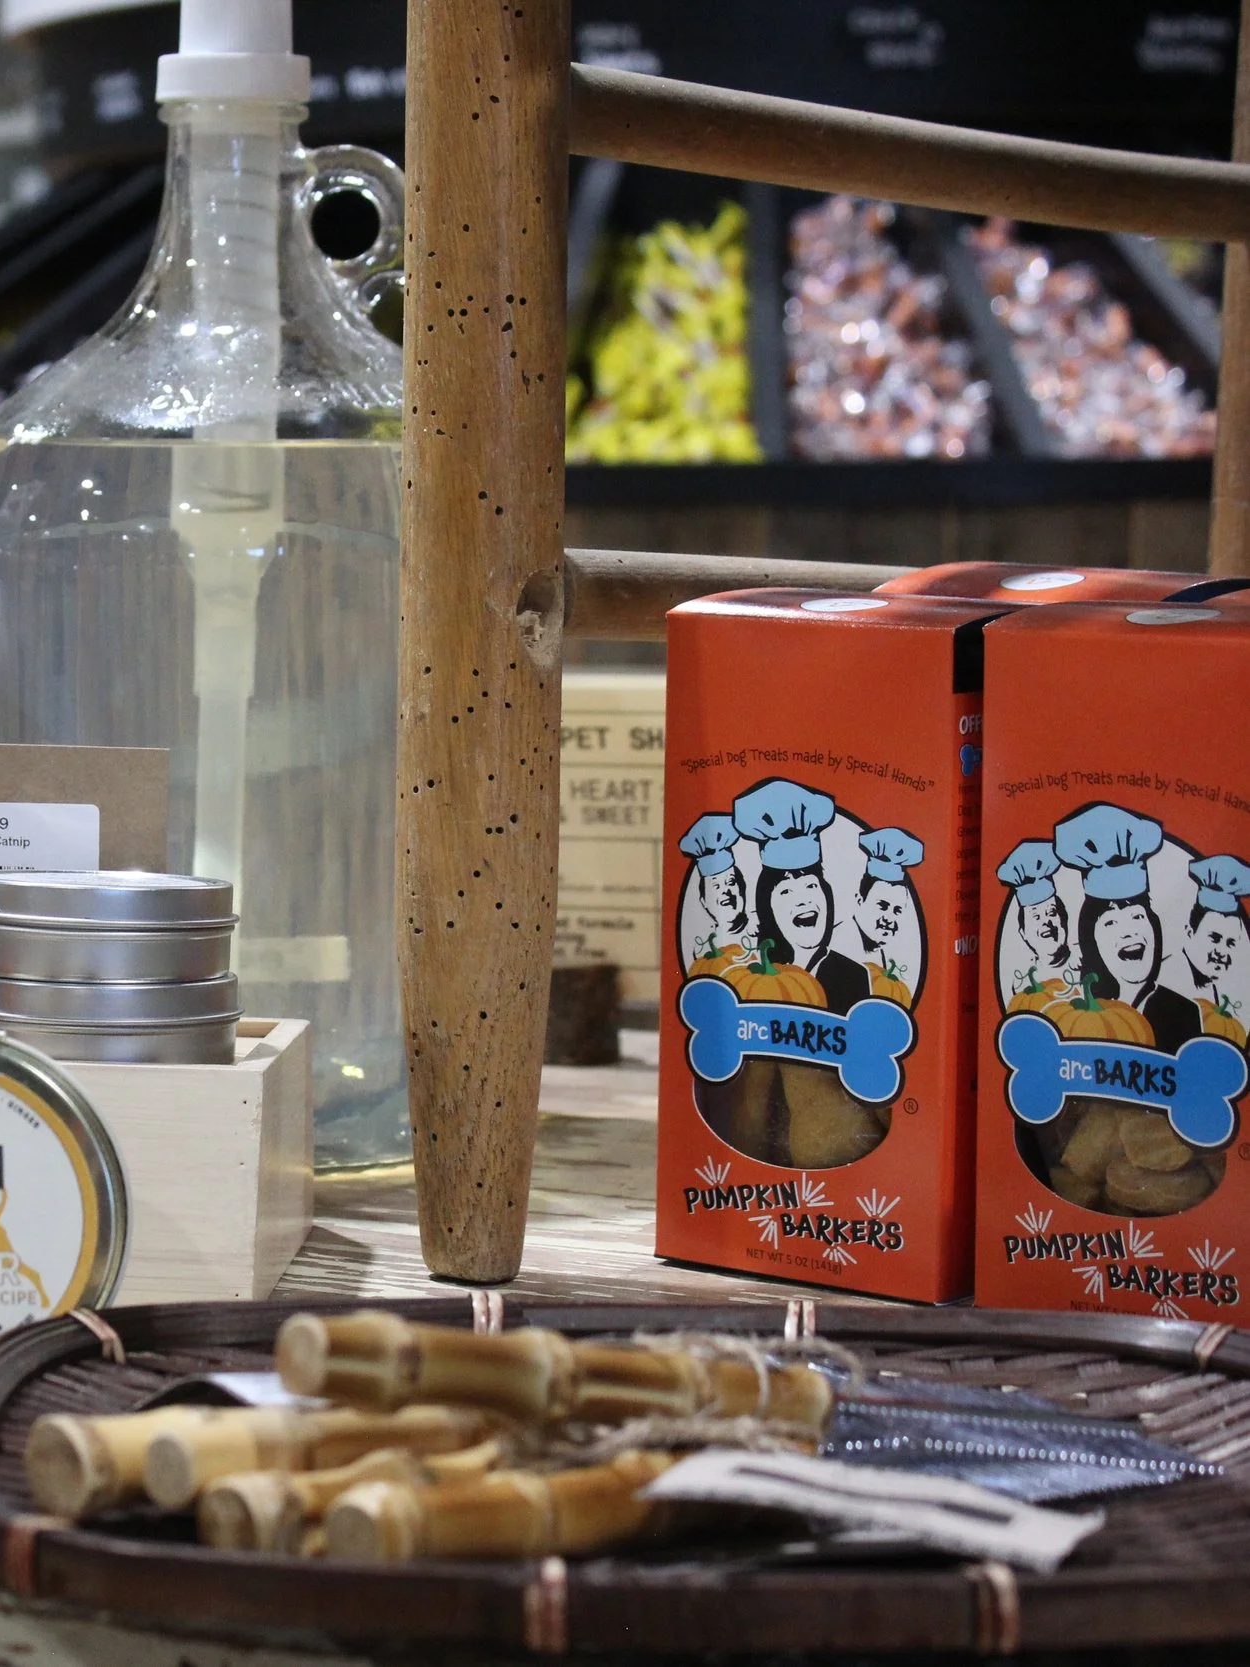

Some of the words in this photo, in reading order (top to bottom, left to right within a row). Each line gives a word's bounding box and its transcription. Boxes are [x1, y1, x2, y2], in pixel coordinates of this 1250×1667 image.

[726, 749, 746, 768] Dog
[749, 747, 789, 762] Treats
[792, 749, 824, 765] made
[827, 750, 843, 773] by
[846, 755, 889, 778] Special
[569, 778, 653, 801] HEART
[1046, 772, 1068, 792] Dog
[1071, 770, 1113, 785] Treats
[1117, 771, 1151, 788] made
[1155, 772, 1172, 796] by
[1174, 778, 1221, 802] Special
[7, 1100, 40, 1129] GINGER
[684, 1180, 801, 1214] PUMPKIN
[780, 1212, 904, 1253] BARKERS
[1003, 1229, 1128, 1265] PUMPKIN
[746, 1247, 765, 1260] NET
[766, 1250, 783, 1262] WT
[785, 1252, 792, 1265] 5
[794, 1255, 809, 1268] OZ
[810, 1258, 843, 1276] (141g)
[1106, 1263, 1239, 1307] BARKERS
[1070, 1300, 1089, 1312] NET
